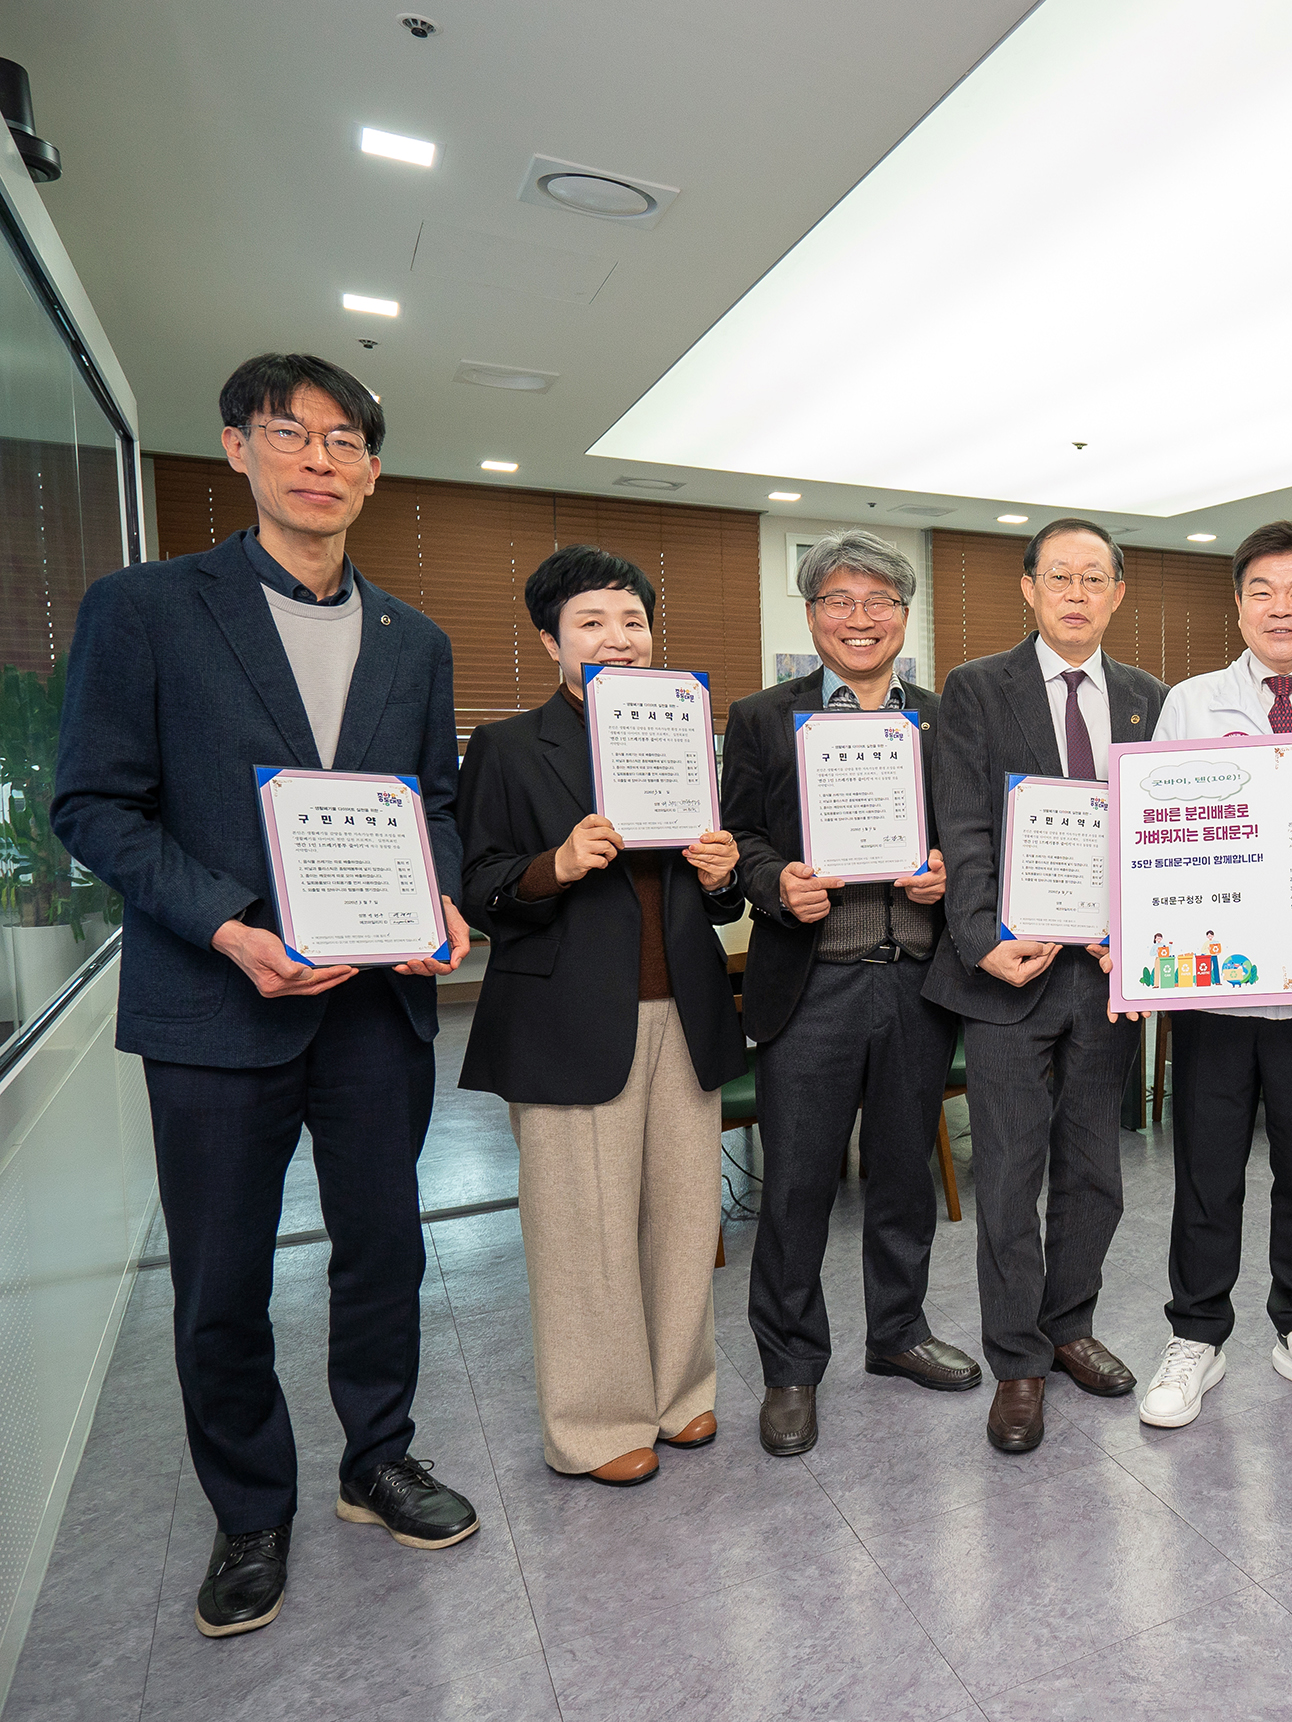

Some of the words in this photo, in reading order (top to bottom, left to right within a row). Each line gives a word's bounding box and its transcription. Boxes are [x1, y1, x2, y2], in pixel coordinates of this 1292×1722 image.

[1152, 779, 1191, 787] 굿바이,
[1143, 807, 1181, 823] 올바른
[1185, 804, 1249, 821] 분리배출로
[1135, 828, 1199, 845] 가벼워지는
[1202, 824, 1259, 842] 동대문구!
[1131, 859, 1152, 869] 35만
[1155, 856, 1211, 868] 동대문구민이
[1213, 853, 1264, 865] 함께합니다!
[1152, 895, 1203, 906] 동대문구청장
[1211, 892, 1241, 904] 이필형
